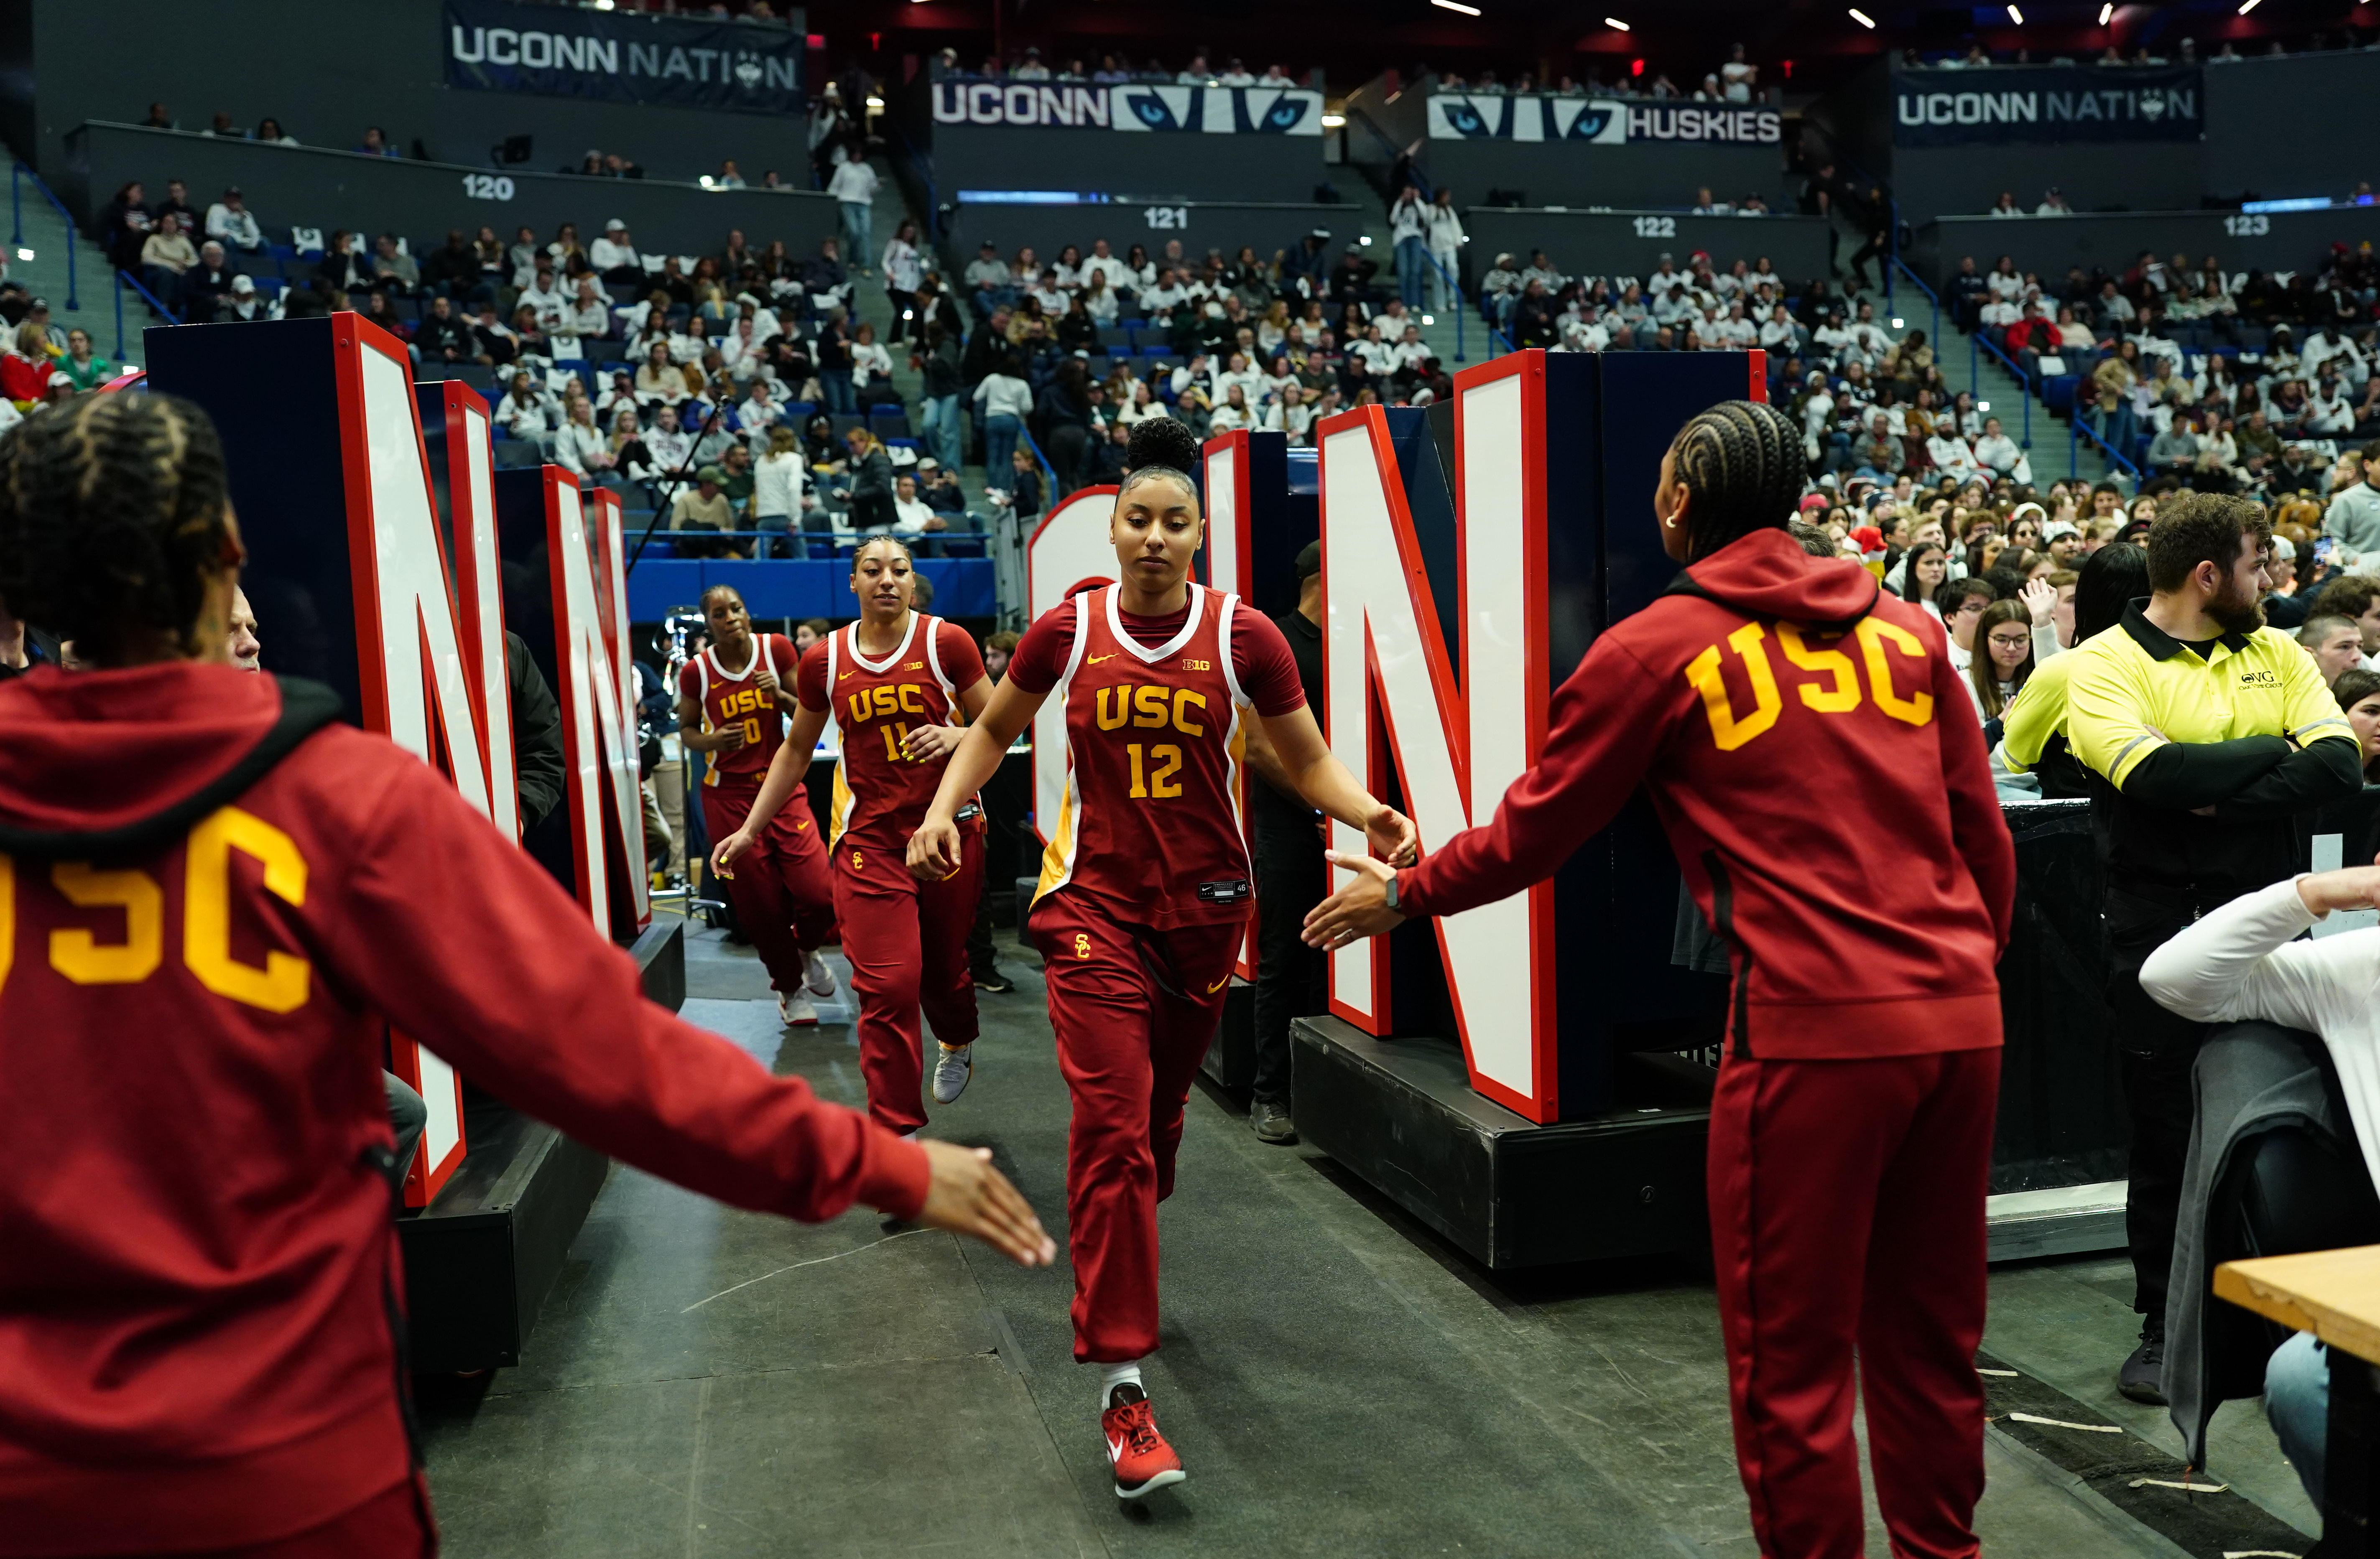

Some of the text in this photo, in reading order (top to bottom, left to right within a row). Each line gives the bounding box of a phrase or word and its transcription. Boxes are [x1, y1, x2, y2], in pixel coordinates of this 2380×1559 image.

[453, 25, 796, 89] UCONN NATIN
[932, 84, 1108, 127] UCONN
[1898, 88, 2194, 126] UCONN NATIN
[1628, 108, 1780, 142] HUSKIES
[462, 174, 514, 201] 120
[1143, 206, 1187, 229] 121
[1633, 216, 1675, 238] 122
[2224, 215, 2270, 236] 123
[1684, 616, 1934, 751] USC
[2241, 671, 2274, 683] OVG
[719, 688, 774, 719] USC
[849, 683, 925, 723] USC
[1096, 684, 1207, 737] USC
[1127, 744, 1182, 798] 12
[1237, 884, 1246, 892] 46
[0, 806, 310, 1013] SC
